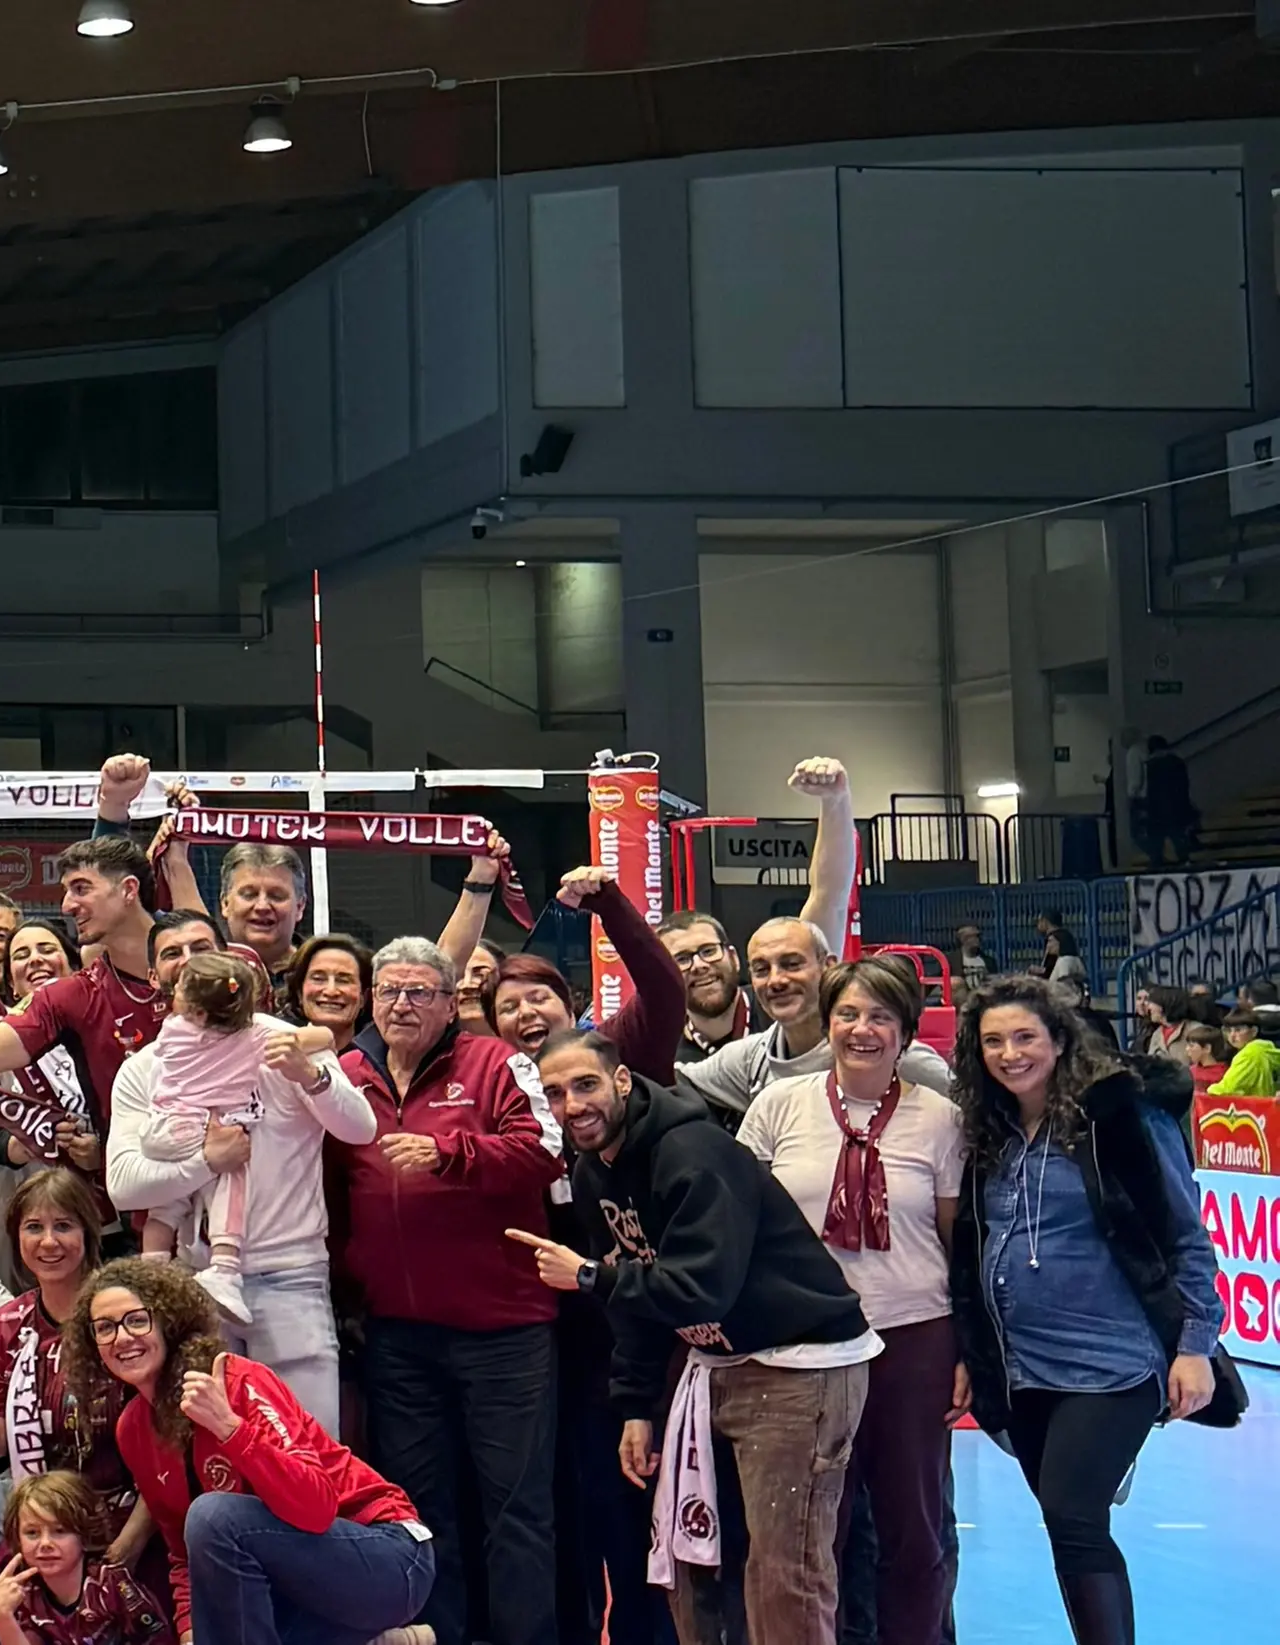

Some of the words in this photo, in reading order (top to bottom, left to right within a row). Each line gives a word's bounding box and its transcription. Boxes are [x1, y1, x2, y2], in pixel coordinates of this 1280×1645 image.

[8, 785, 100, 807] VOLL
[176, 811, 325, 841] OMOTEK
[358, 815, 485, 846] VOLLE
[645, 820, 661, 888] Monte
[728, 838, 809, 858] USCITA
[1133, 872, 1271, 938] FORZA
[1224, 1139, 1261, 1168] Monte
